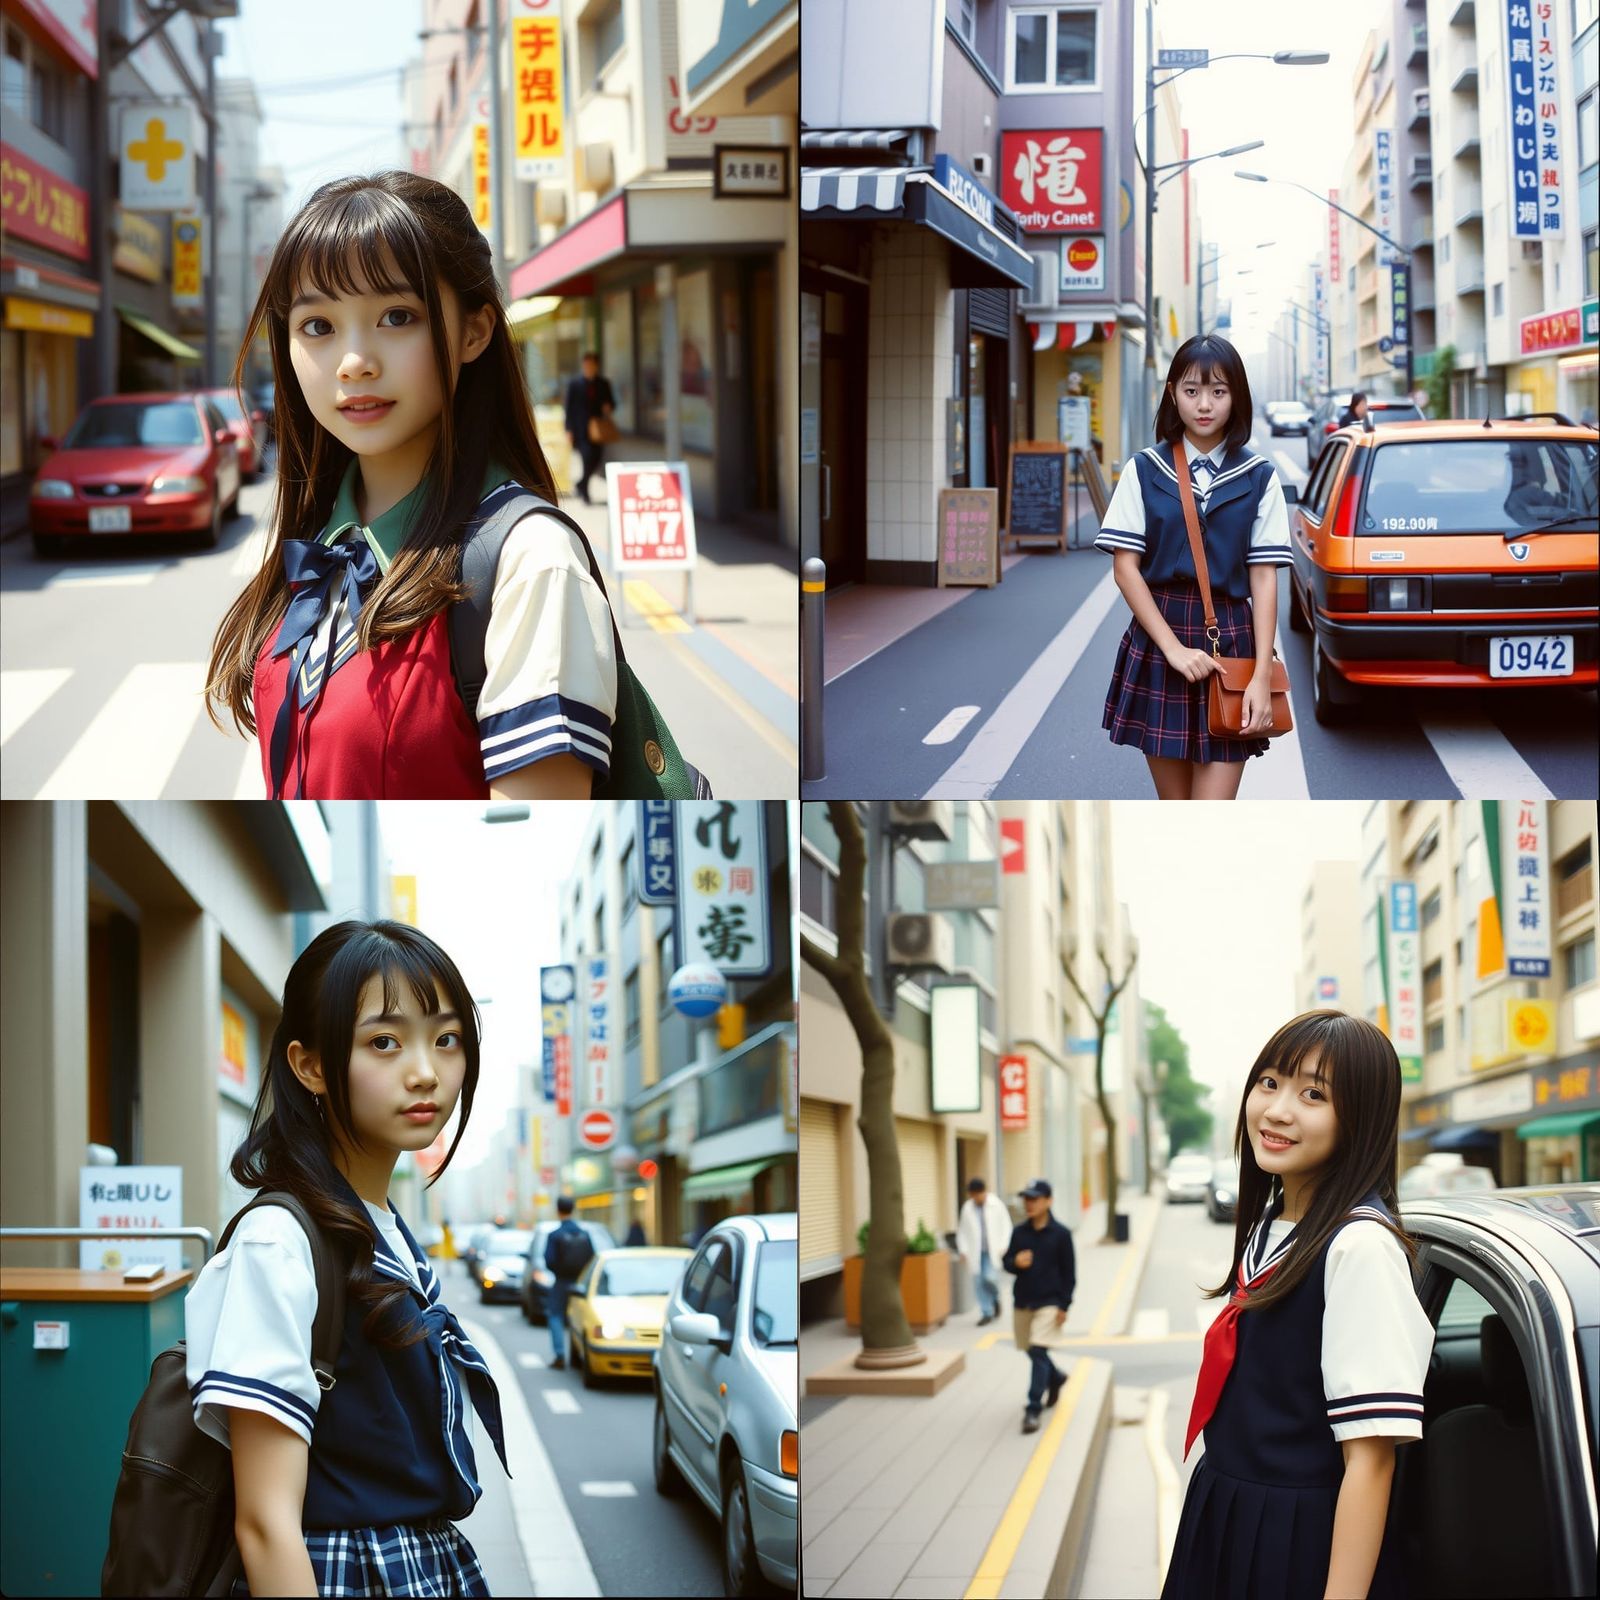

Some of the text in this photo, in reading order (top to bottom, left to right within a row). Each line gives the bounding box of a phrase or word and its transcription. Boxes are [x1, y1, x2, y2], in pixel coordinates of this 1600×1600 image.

[1052, 210, 1094, 226] Canet
[622, 511, 681, 545] M7
[1500, 641, 1566, 671] 0942
